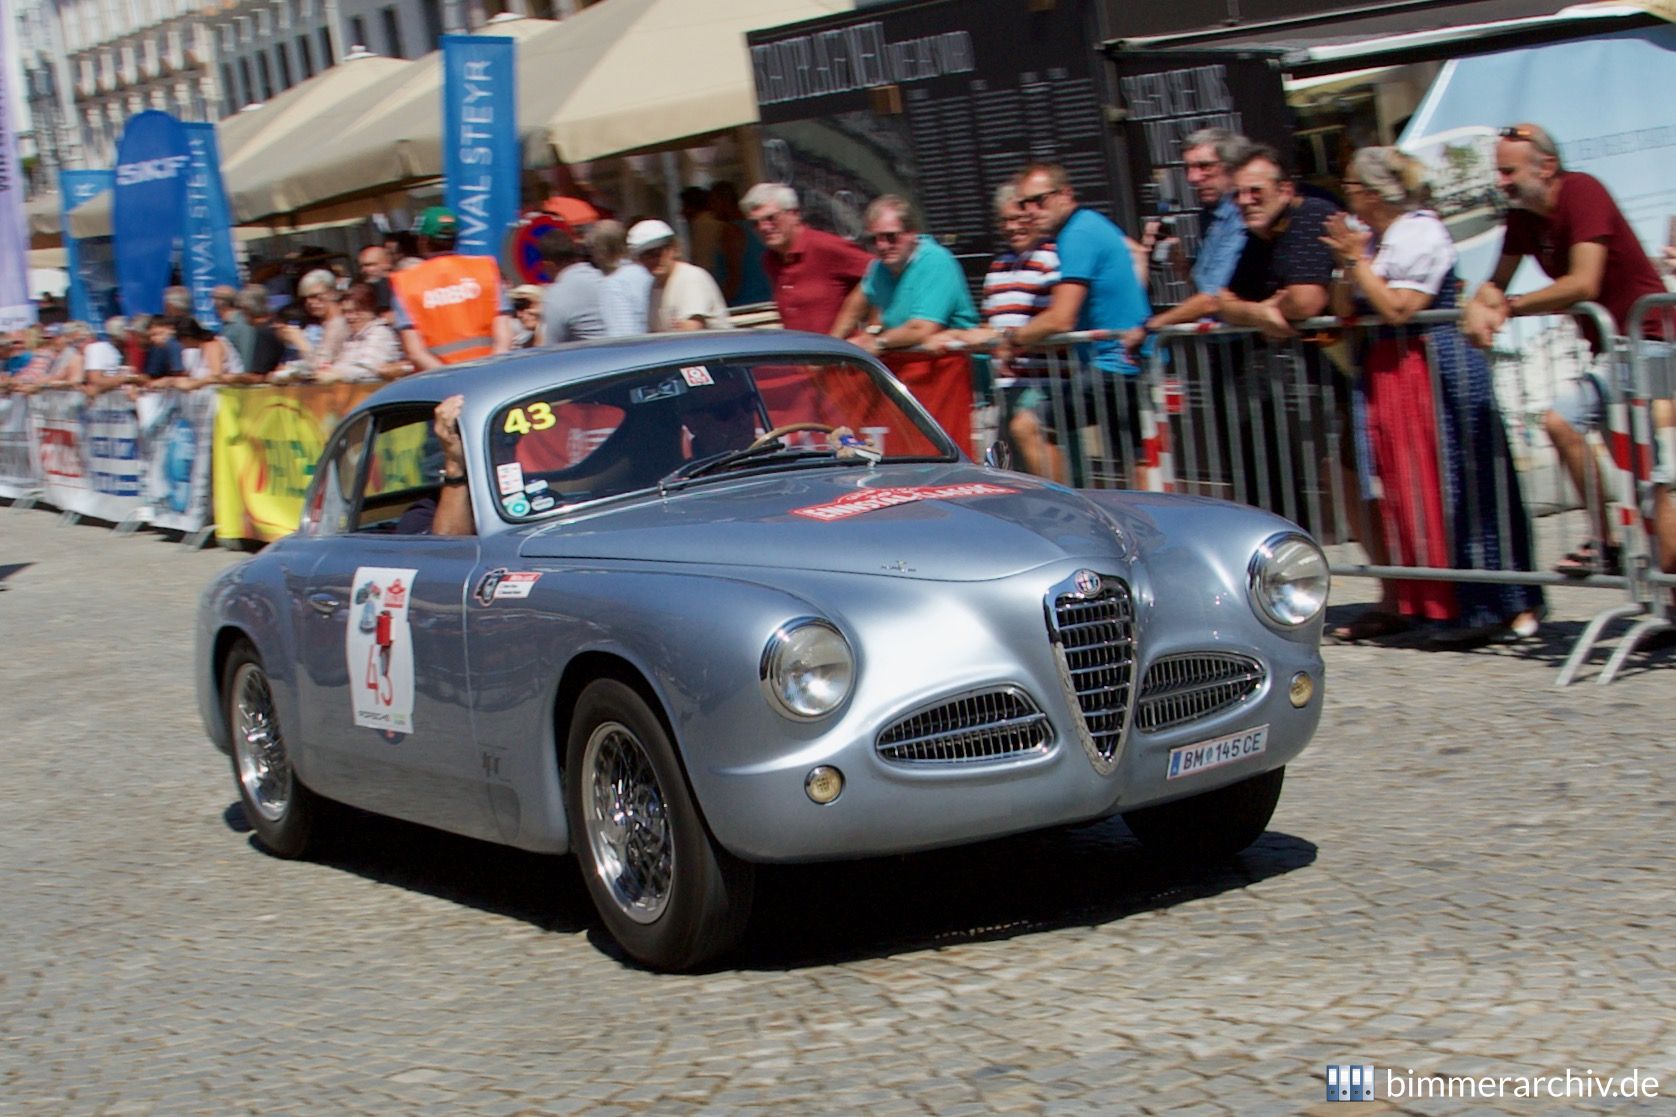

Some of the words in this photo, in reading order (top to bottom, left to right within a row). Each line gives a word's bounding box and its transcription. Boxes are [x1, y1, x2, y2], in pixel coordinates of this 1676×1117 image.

[459, 60, 493, 165] STEYR
[117, 155, 190, 185] SKF
[459, 175, 492, 247] IVAL
[504, 402, 556, 434] 43
[1183, 748, 1205, 770] BM
[1216, 739, 1241, 761] 145
[1243, 733, 1261, 754] CE
